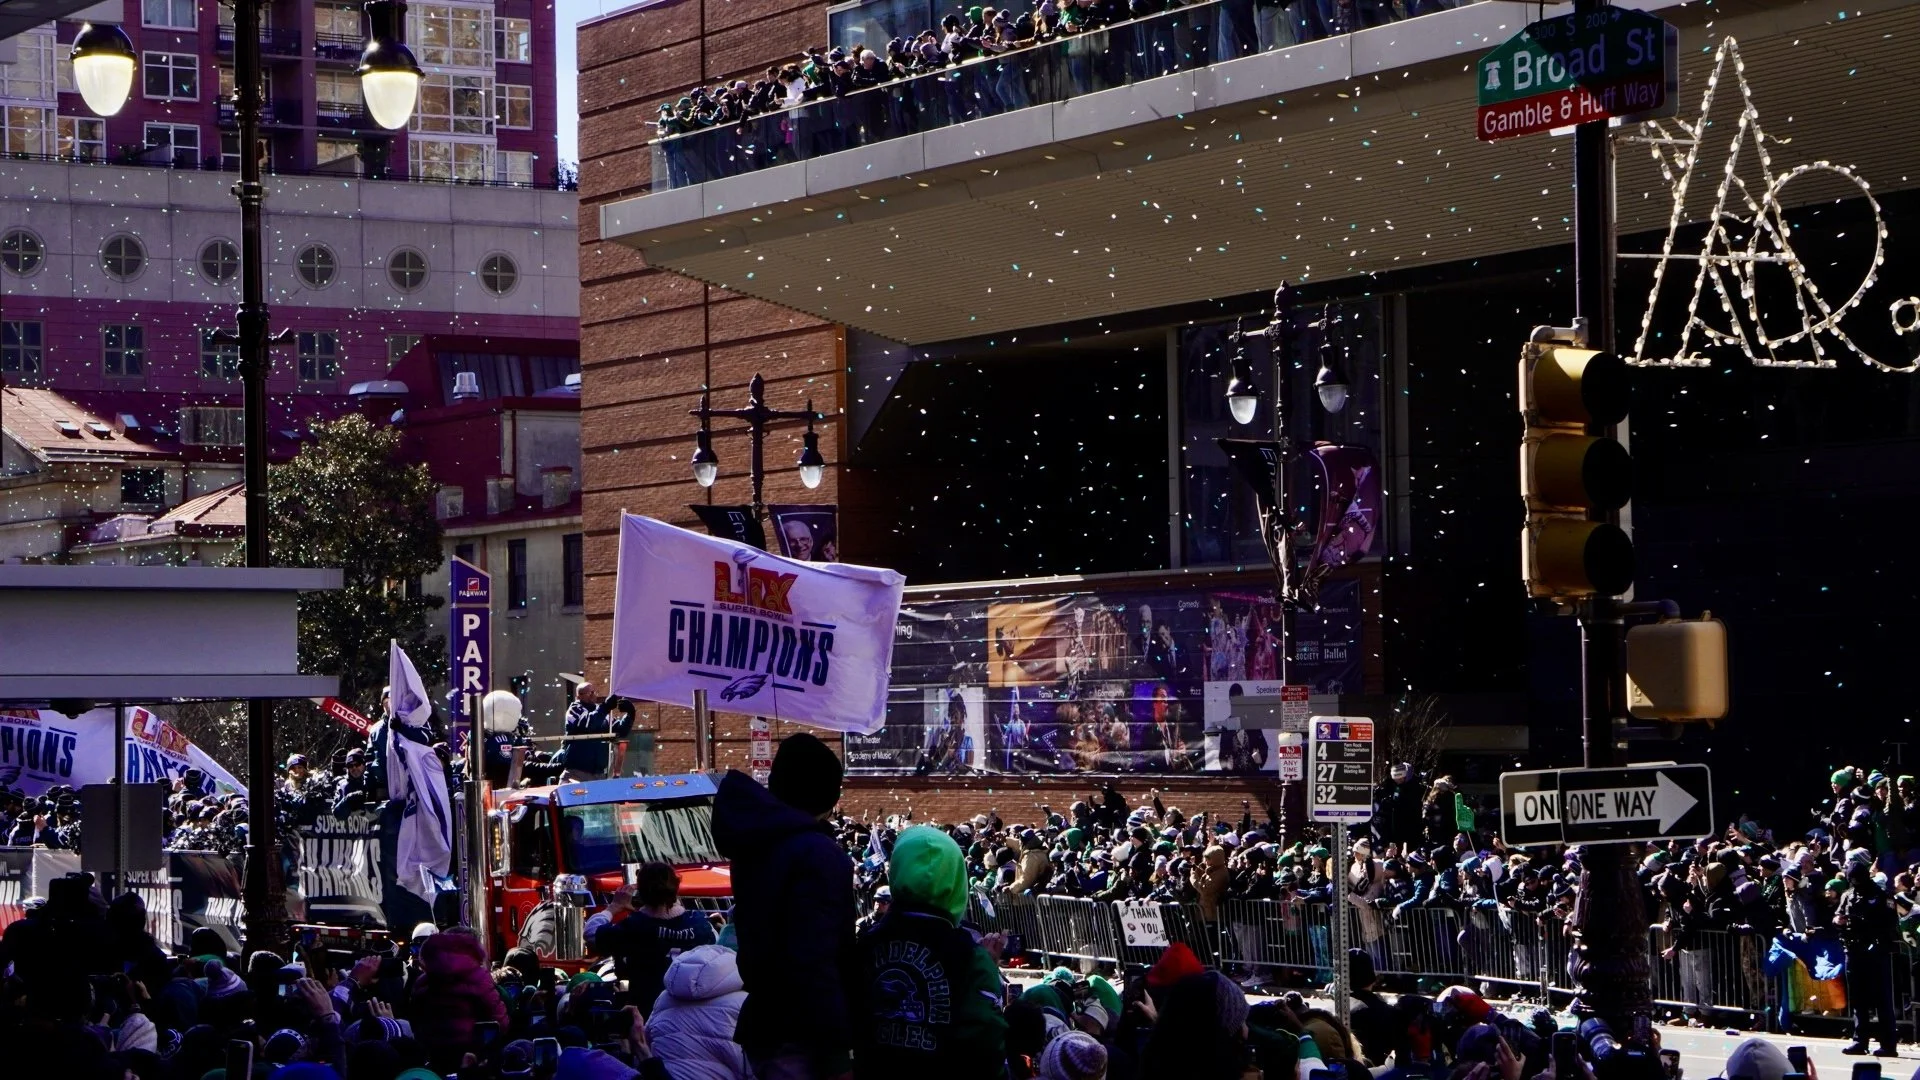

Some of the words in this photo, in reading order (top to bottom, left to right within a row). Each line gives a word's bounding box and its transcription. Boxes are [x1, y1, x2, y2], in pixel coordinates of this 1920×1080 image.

[1566, 16, 1576, 38] S
[1586, 11, 1608, 29] 200
[1513, 33, 1606, 90] Broad
[1626, 26, 1656, 66] St
[1483, 102, 1553, 134] Gamble
[1560, 96, 1573, 120] &
[1580, 86, 1617, 117] Huff
[1623, 81, 1660, 106] Way
[720, 602, 757, 616] SUPER
[760, 608, 787, 622] BOWL
[668, 608, 836, 687] CHAMPIONS
[1317, 742, 1328, 760] 4
[1317, 764, 1336, 782] 27
[1317, 785, 1336, 803] 32
[1570, 792, 1607, 820] ONE
[1614, 790, 1656, 818] WAY
[314, 814, 346, 834] SUPER
[1130, 908, 1158, 919] THANK
[1140, 922, 1158, 934] YOU
